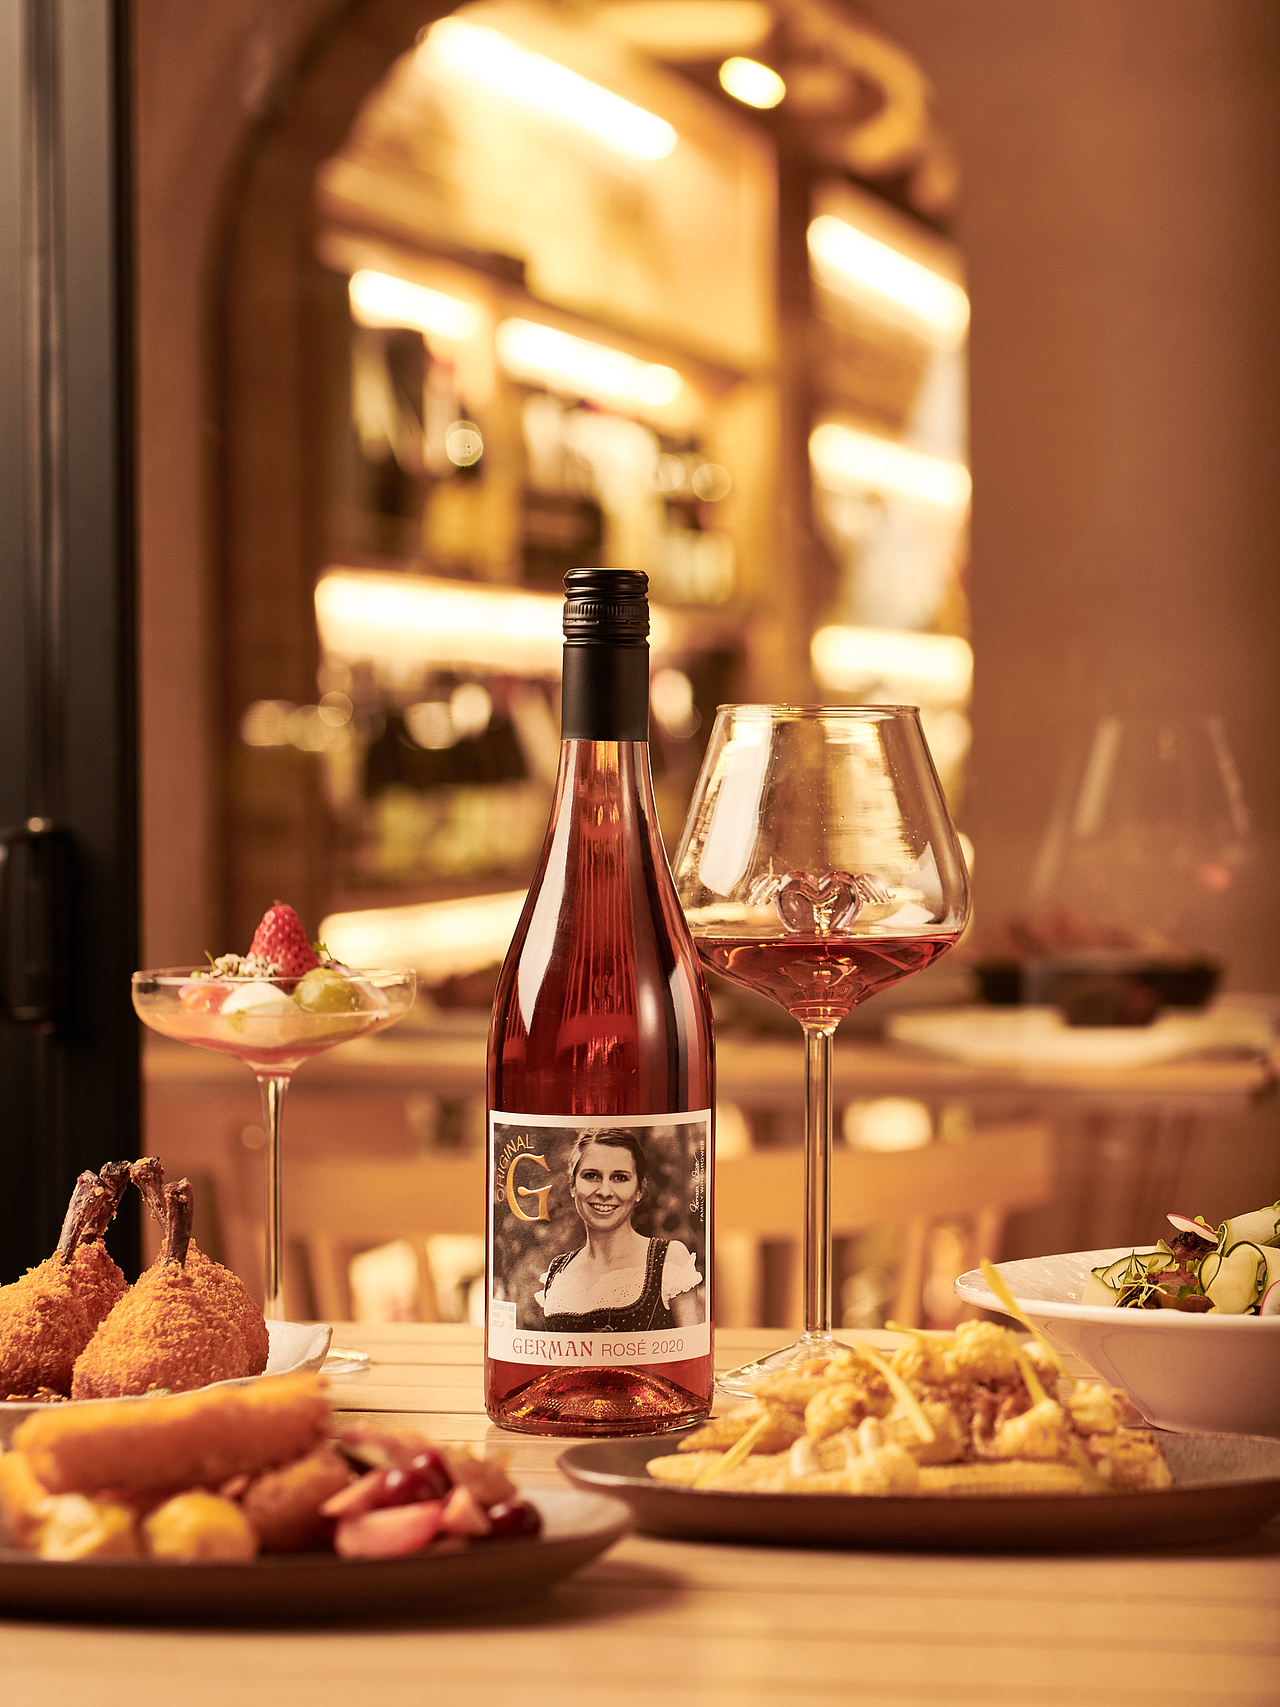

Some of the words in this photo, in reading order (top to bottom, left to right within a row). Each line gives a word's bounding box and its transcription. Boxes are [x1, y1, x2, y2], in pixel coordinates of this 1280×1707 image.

[497, 1133, 535, 1202] ORIGINAL
[506, 1152, 552, 1222] G
[512, 1337, 593, 1360] GERMAN
[601, 1339, 646, 1356] ROSÉ
[651, 1339, 684, 1355] 2020
